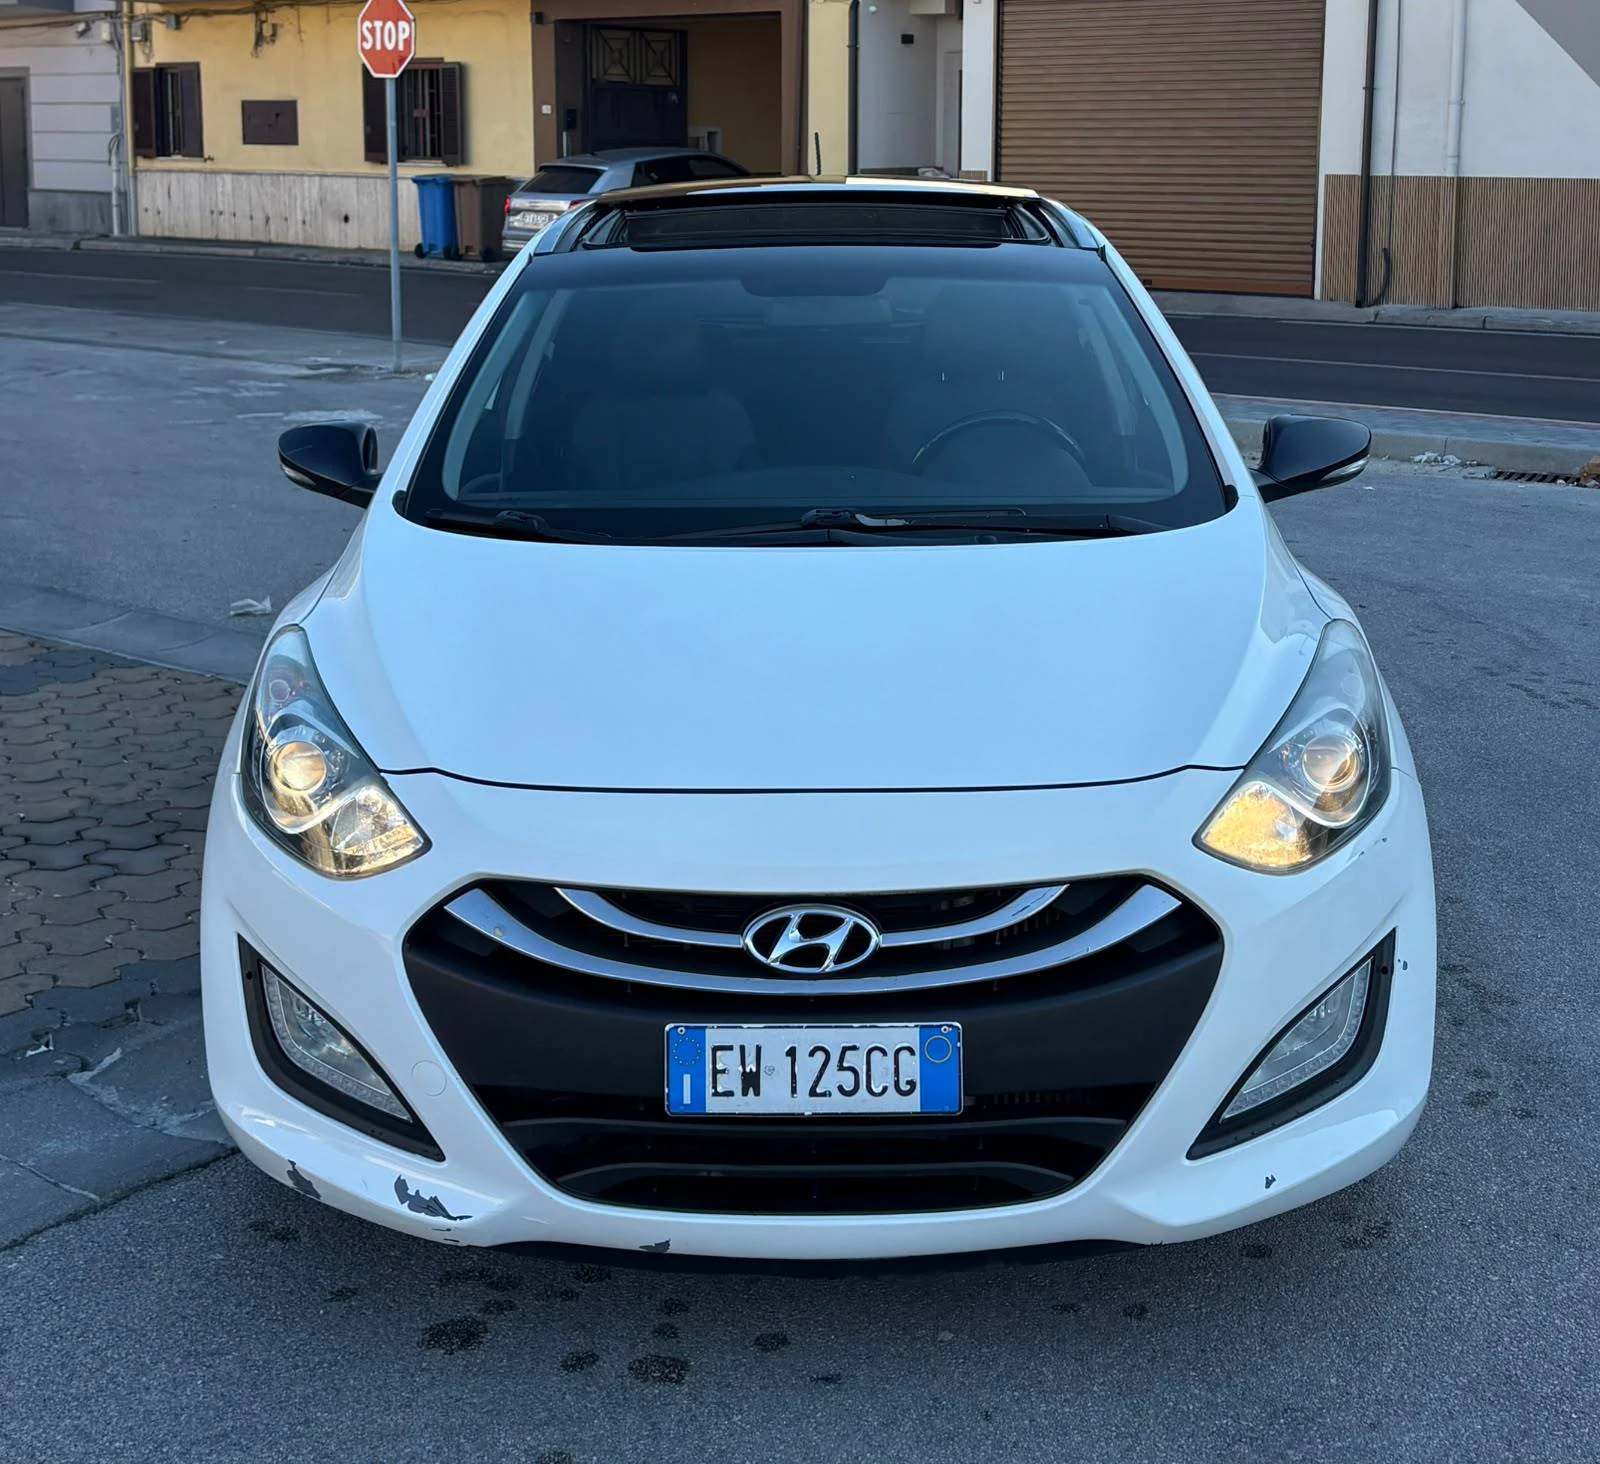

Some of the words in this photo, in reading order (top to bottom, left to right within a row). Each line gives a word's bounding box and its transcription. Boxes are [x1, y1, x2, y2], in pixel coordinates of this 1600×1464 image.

[361, 20, 410, 51] STOP
[711, 1044, 762, 1097] EW
[785, 1045, 917, 1098] 125CG
